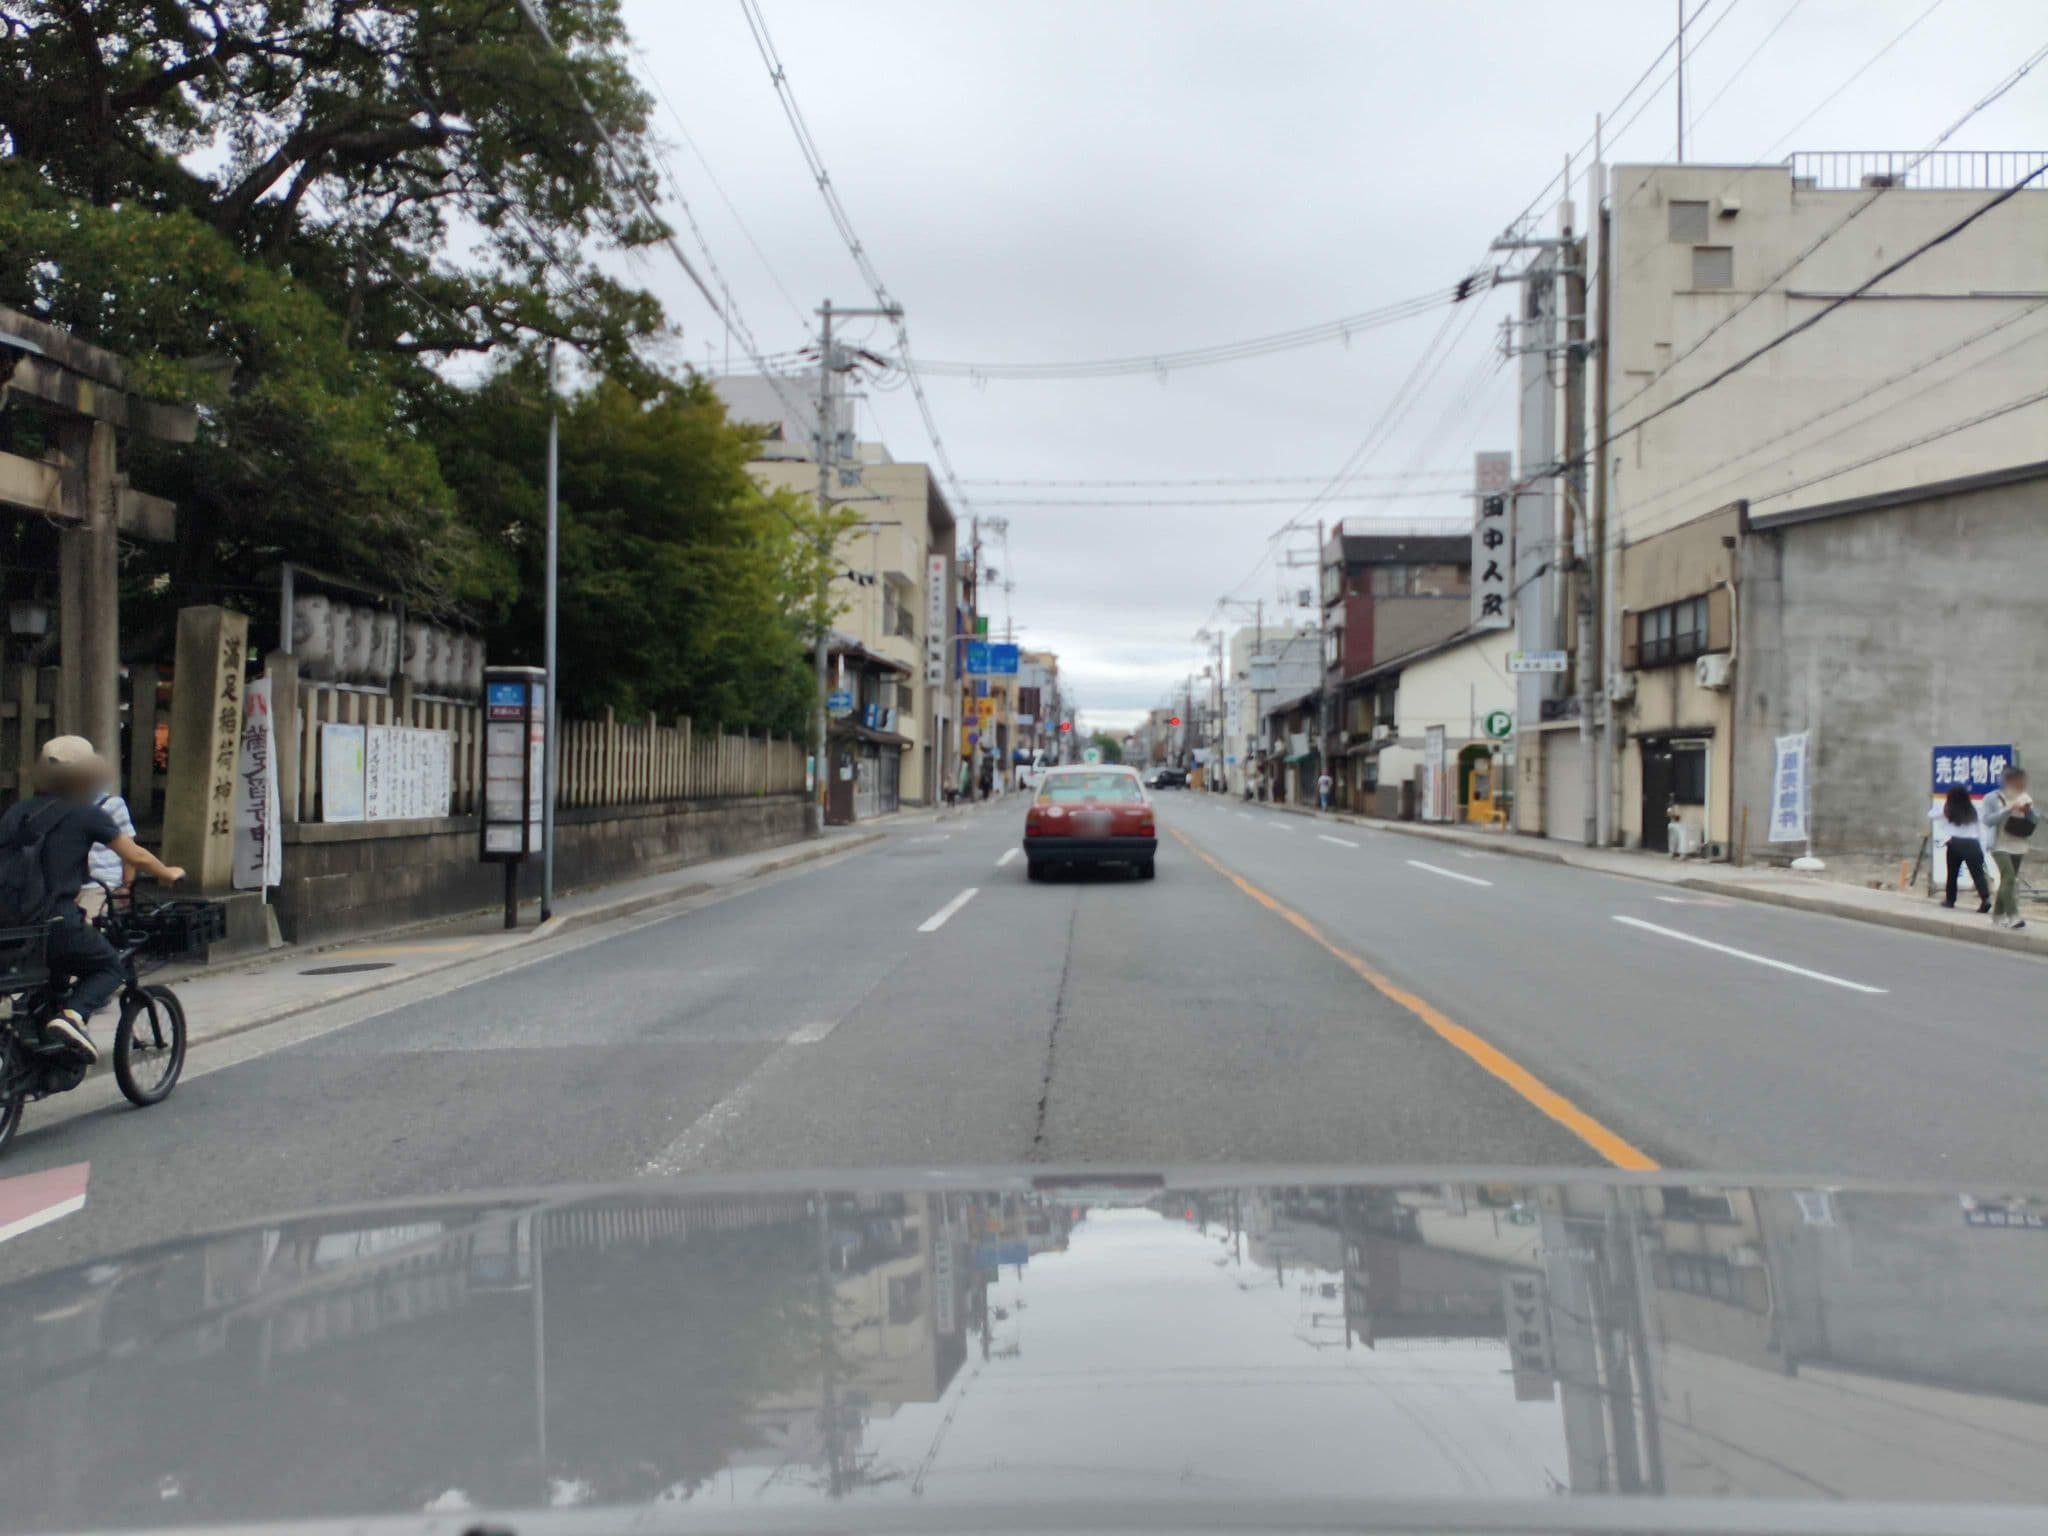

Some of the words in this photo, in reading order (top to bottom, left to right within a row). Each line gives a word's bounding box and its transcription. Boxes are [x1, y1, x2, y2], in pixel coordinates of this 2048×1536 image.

[1492, 714, 1510, 735] P
[1935, 754, 2007, 784] 売却物件
